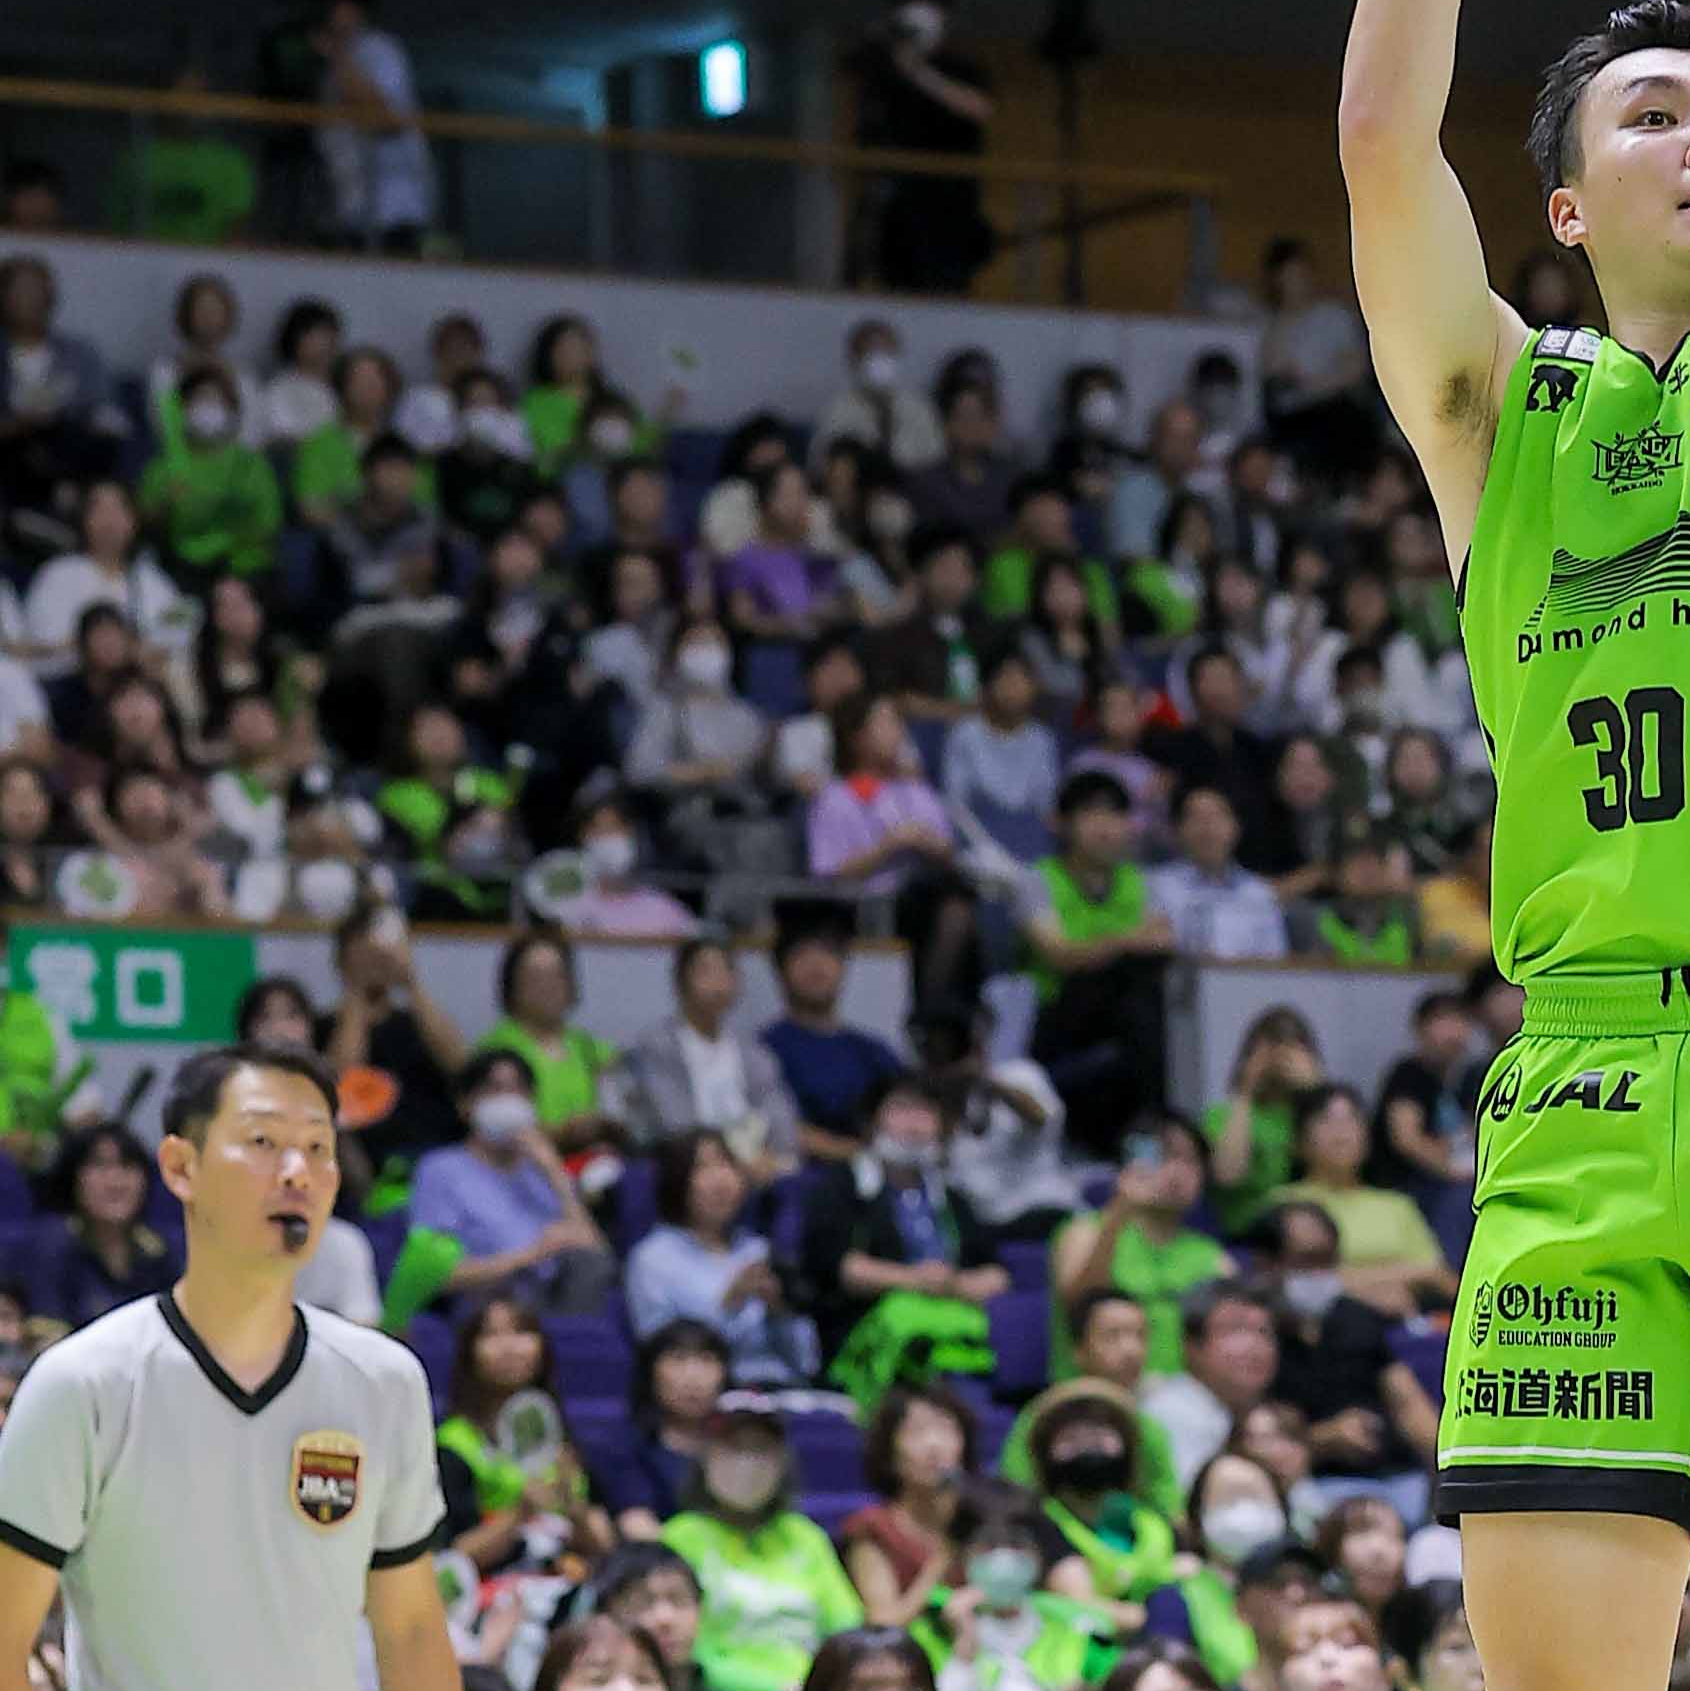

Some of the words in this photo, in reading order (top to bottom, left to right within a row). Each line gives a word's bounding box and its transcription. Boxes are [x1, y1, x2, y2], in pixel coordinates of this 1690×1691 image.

[1518, 601, 1646, 663] Dmond
[1567, 686, 1686, 834] 30
[1523, 1070, 1642, 1113] JAL
[1497, 1282, 1619, 1330] Ohfuji
[1498, 1330, 1572, 1347] EDUCATION
[1574, 1332, 1617, 1349] GROUP
